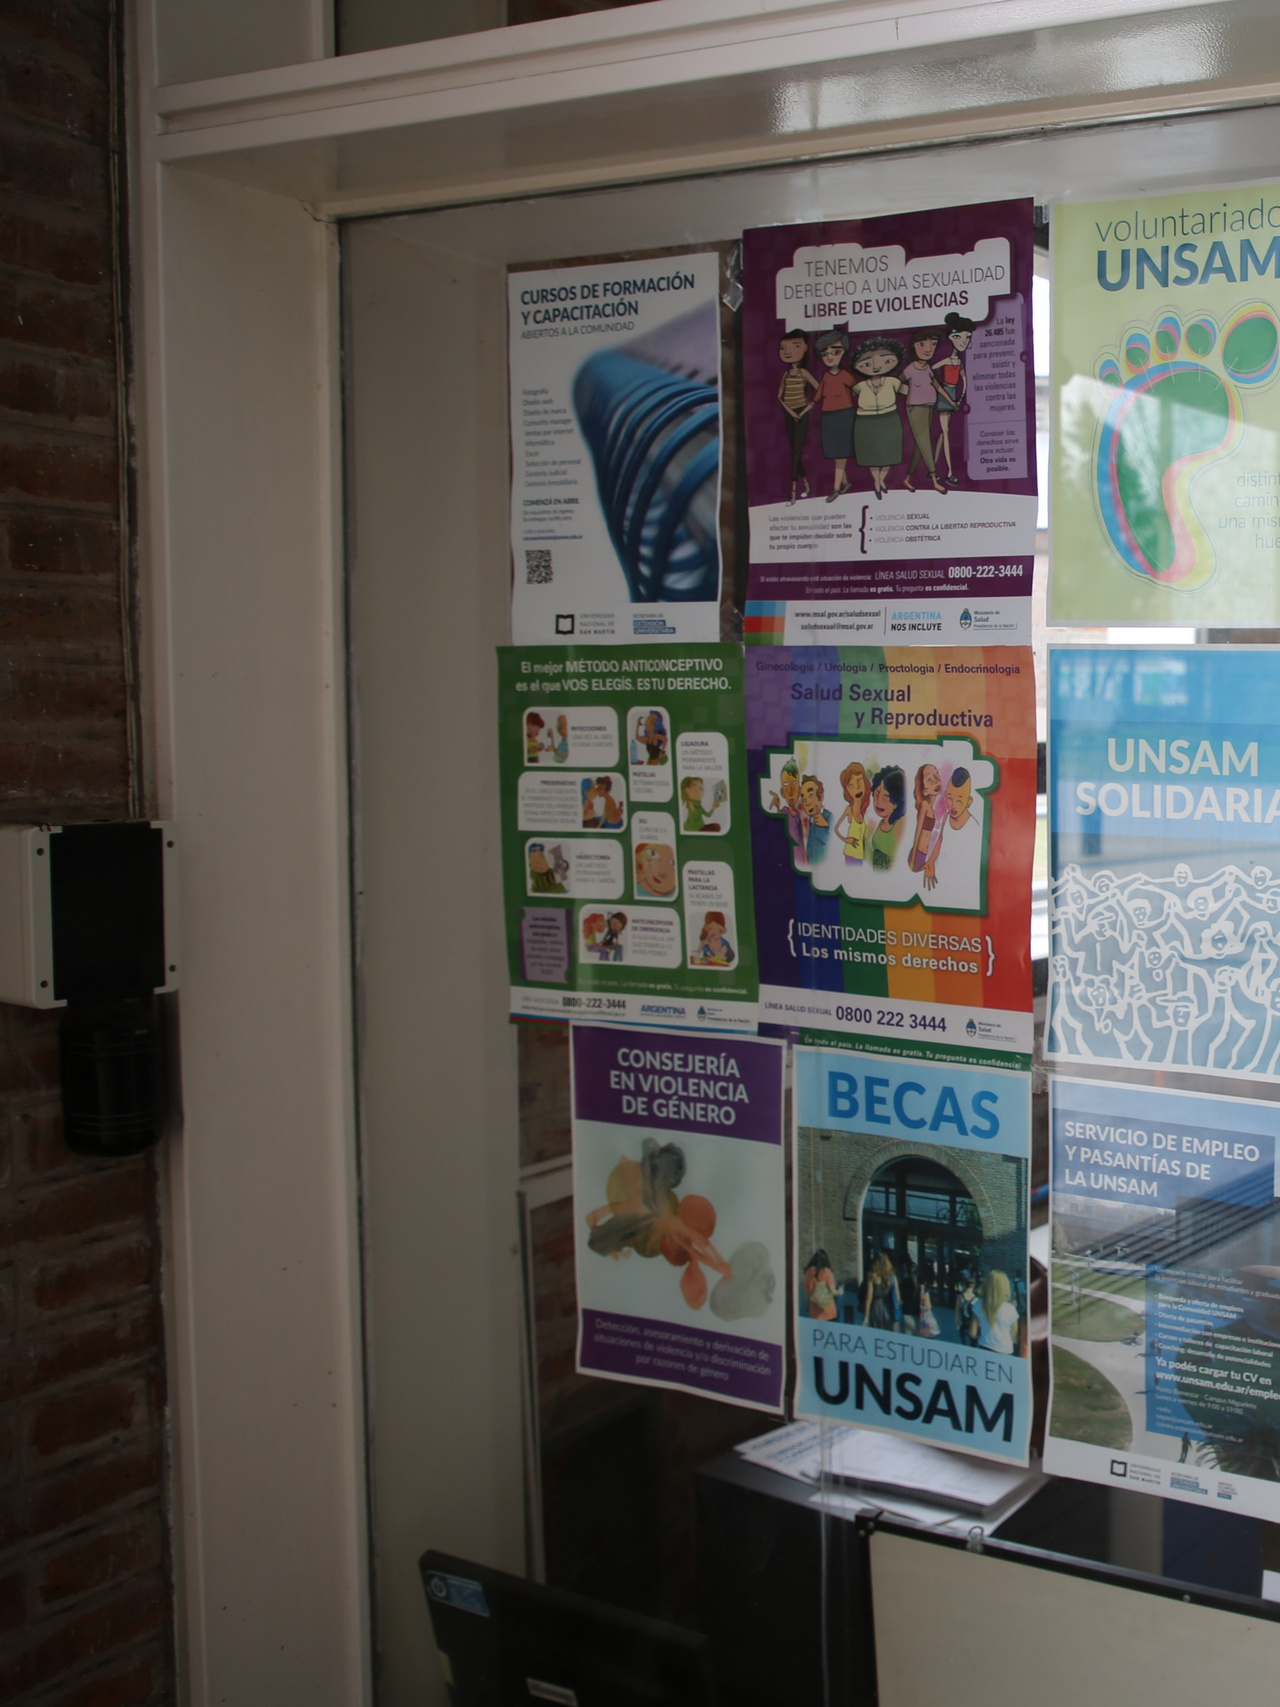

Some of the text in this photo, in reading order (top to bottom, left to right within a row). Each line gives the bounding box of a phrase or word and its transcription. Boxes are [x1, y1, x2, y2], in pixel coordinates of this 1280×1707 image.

[804, 255, 889, 278] TENEMOS
[521, 271, 695, 305] CURSOS DE FORMACIÓN
[784, 265, 1005, 300] DERECHO A UNA SEXUALIDAD
[521, 298, 639, 325] Y CAPACITACIÓN
[804, 291, 968, 318] LIBRE DE VIOLENCIAS
[521, 321, 635, 340] ABIERTOS A LA COMUNIDAD
[1005, 316, 1015, 325] ley
[973, 351, 988, 360] para
[979, 338, 1015, 348] sancionada
[972, 371, 1016, 381] eliminar todas
[974, 382, 1016, 391] las violencias
[985, 392, 1016, 401] contra las
[970, 521, 1016, 529] REPRODUCTIVA
[1219, 517, 1246, 528] una
[875, 565, 1023, 581] LÍNEA SALUD SEXUAL 0800-222-3444
[891, 622, 942, 631] NOS INCLUYE
[892, 611, 942, 620] ARGENTINA
[521, 658, 723, 676] El mejor MÉTODO ANTICONCEPTIVO
[756, 662, 1020, 675] Ginecología Urología Proctología Endocrinología
[516, 676, 732, 694] es el que VOS ELEGÍS. ES TU DERECHO.
[791, 683, 911, 702] Salud Sexual
[854, 708, 994, 729] y Reproductiva
[1107, 738, 1258, 777] UNSAM
[798, 922, 982, 953] IDENTIDADES DIVERSAS
[802, 942, 978, 974] Los mismos derechos
[764, 1001, 947, 1032] LÍNEA SALUD SEXUAL 0800 222 3444
[617, 1047, 741, 1078] CONSEJERÍA
[610, 1070, 749, 1104] EN VIOLENCIA
[622, 1095, 736, 1125] DE GÉNERO
[828, 1070, 1000, 1140] BECAS
[1065, 1121, 1260, 1162] SERVICIO DE EMPLEO
[1064, 1145, 1211, 1181] Y PASANTÍAS DE
[1065, 1169, 1158, 1197] LA UNSAM
[813, 1329, 1013, 1384] PARA ESTUDIAR EN
[1155, 1356, 1272, 1386] Ya podés cargar tu CV en
[814, 1356, 1014, 1443] UNSAM
